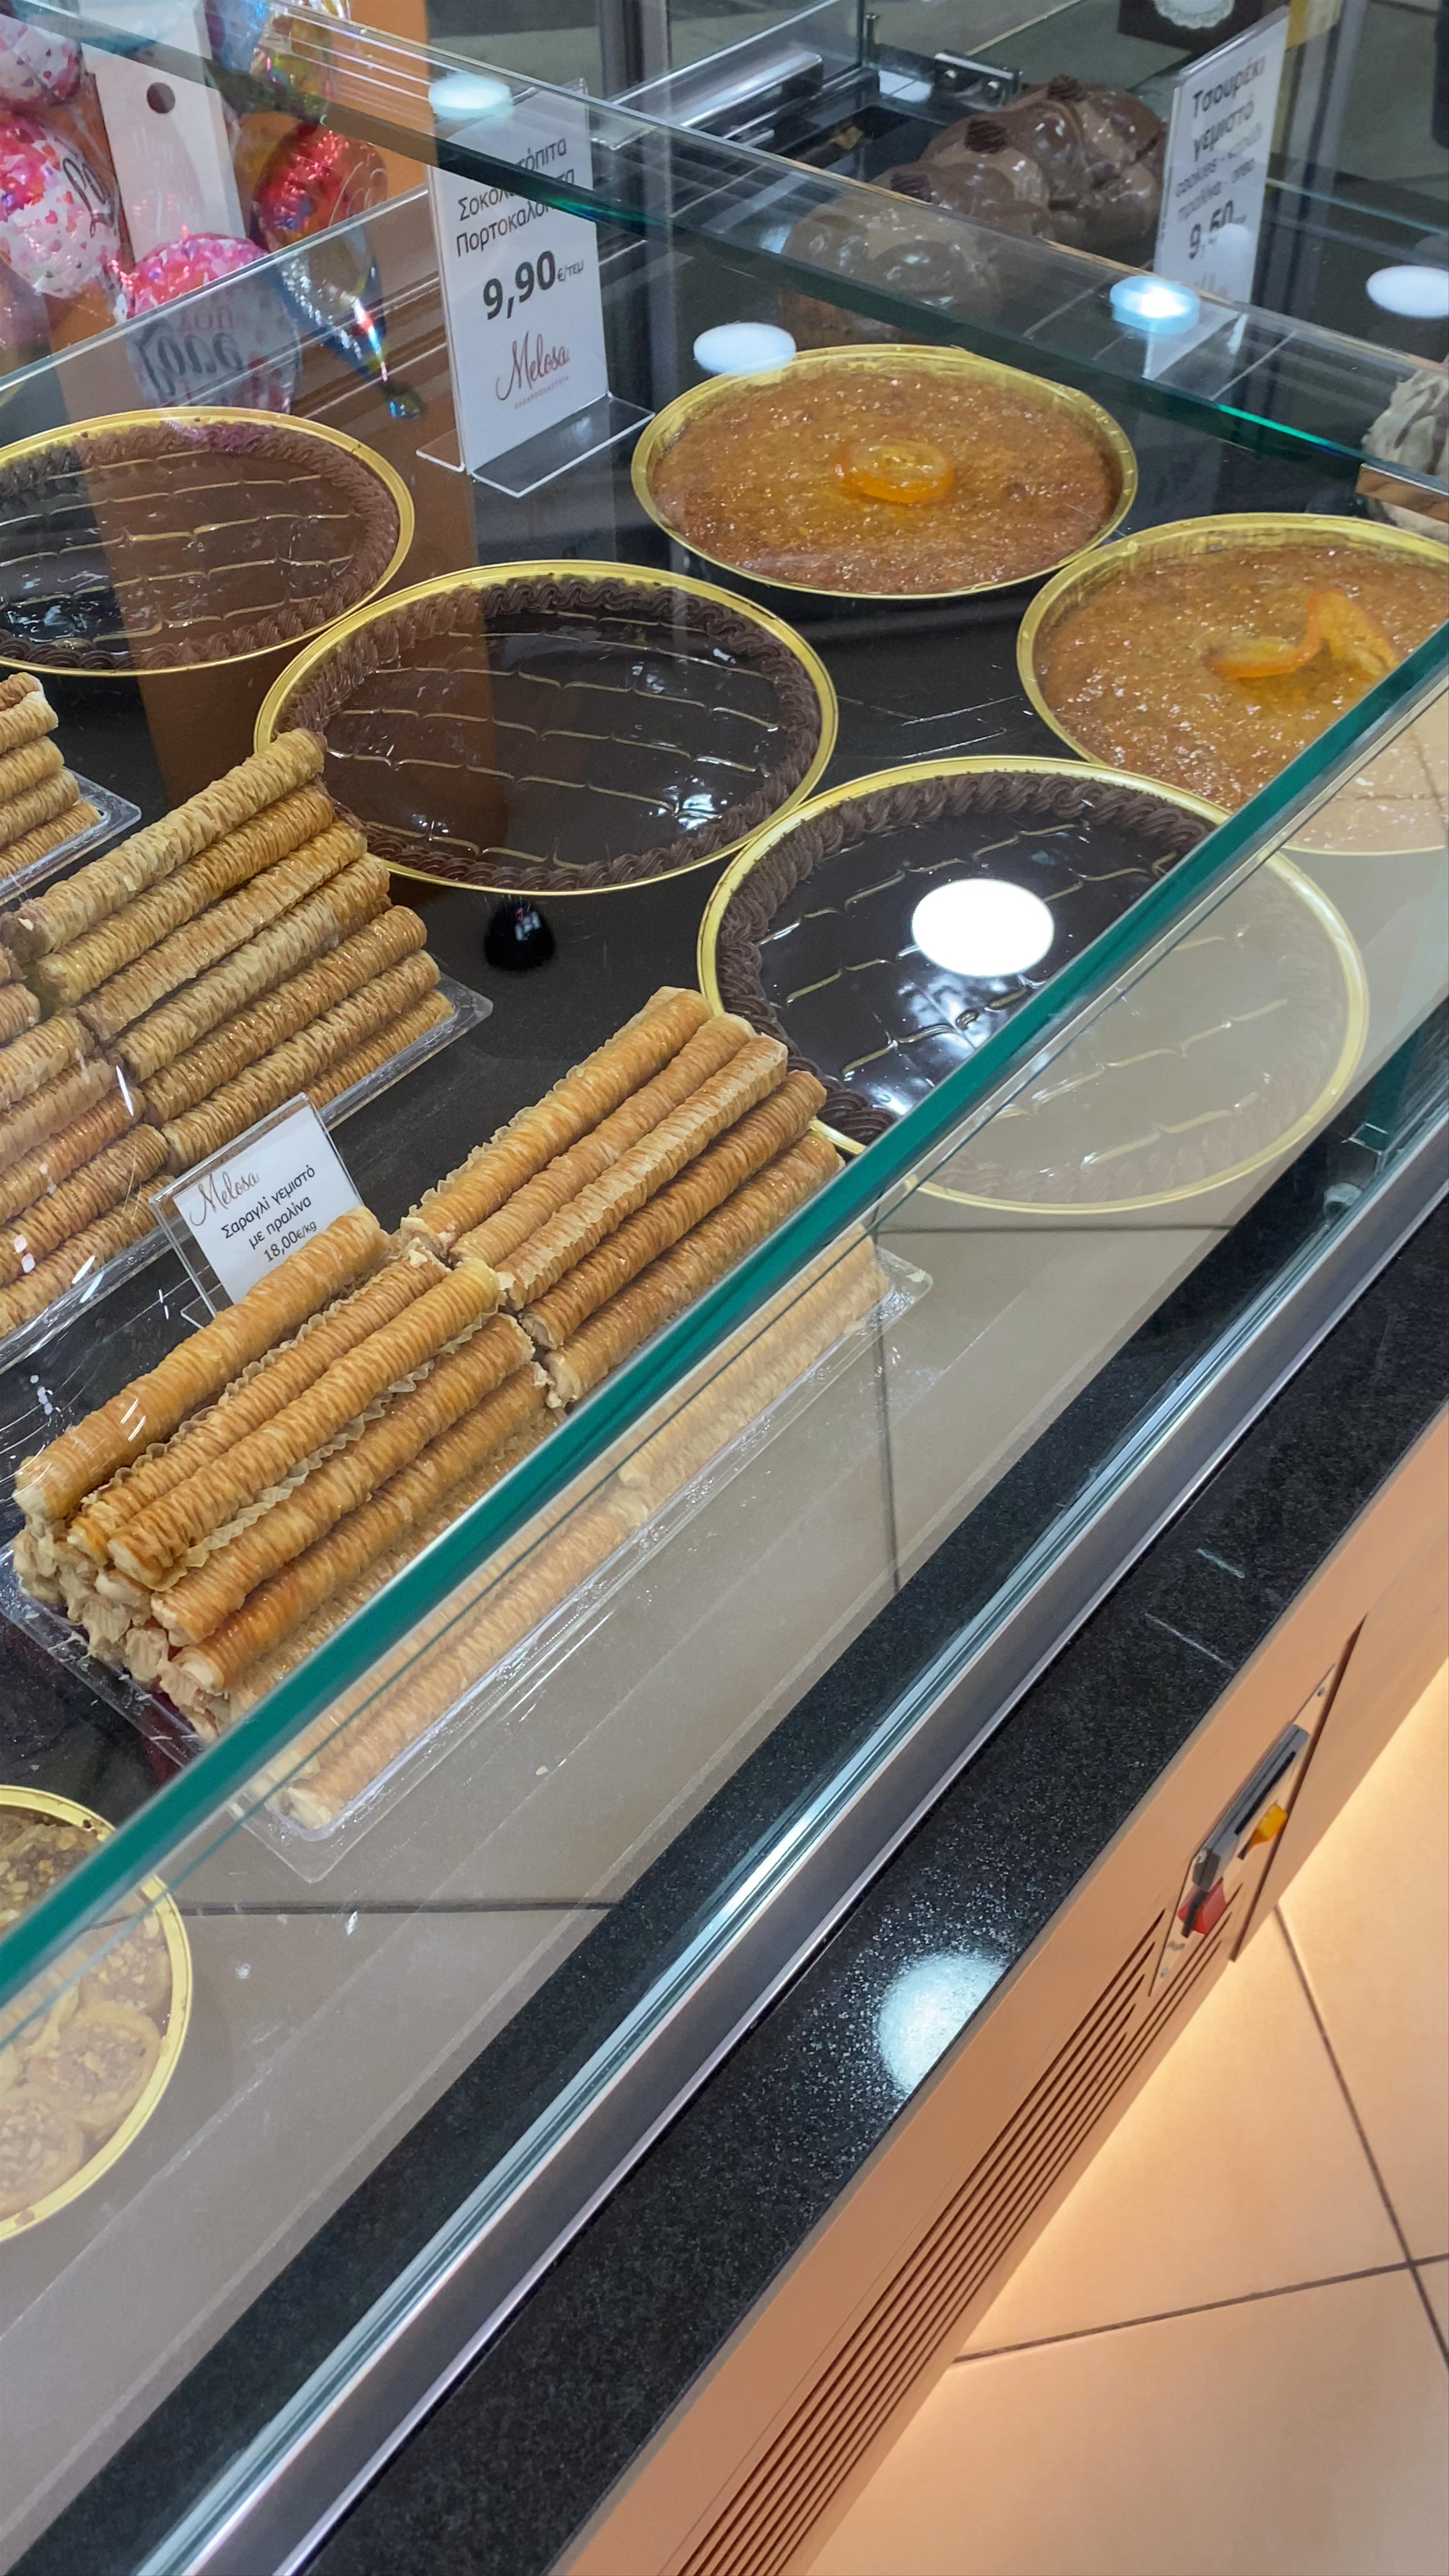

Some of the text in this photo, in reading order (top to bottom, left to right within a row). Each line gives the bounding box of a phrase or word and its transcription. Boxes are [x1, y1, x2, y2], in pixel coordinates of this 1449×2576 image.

[495, 331, 570, 401] Melosa
[189, 1171, 261, 1226] Melosa
[221, 1164, 315, 1239] Σαραγλί γεμιστό
[249, 1196, 312, 1250] με πραλίνα
